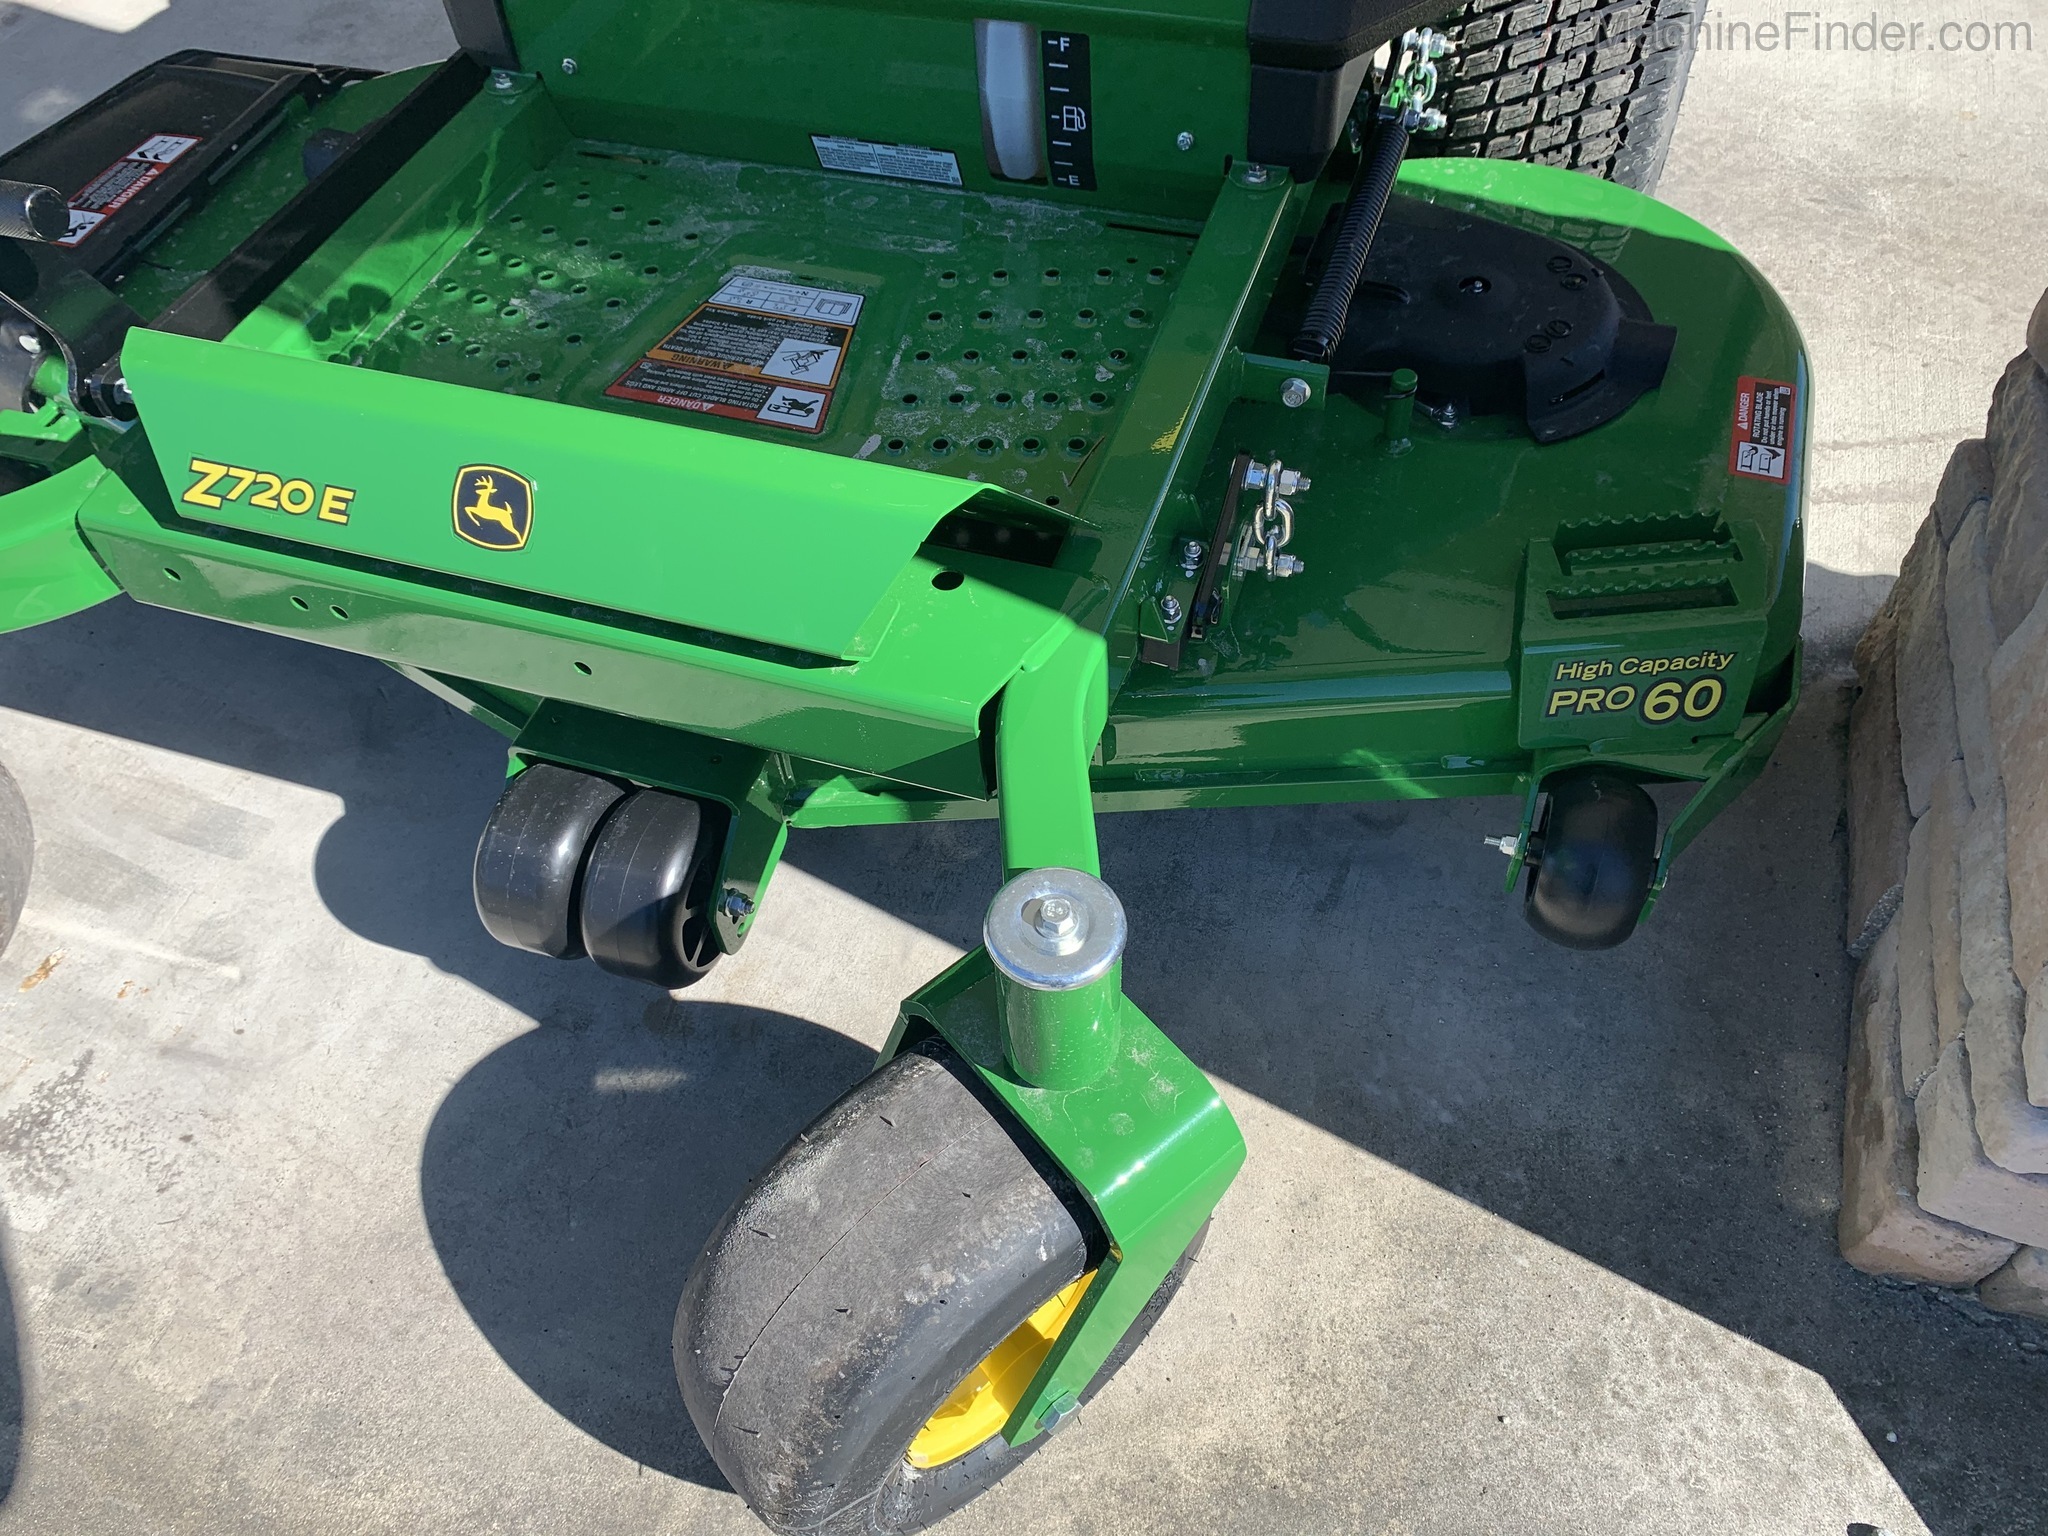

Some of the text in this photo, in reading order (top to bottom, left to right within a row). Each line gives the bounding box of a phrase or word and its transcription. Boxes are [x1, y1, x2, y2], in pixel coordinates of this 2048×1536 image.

[1060, 37, 1070, 52] F
[1068, 174, 1080, 186] E
[107, 176, 149, 208] DANGER
[671, 354, 720, 367] WARNING
[657, 395, 700, 409] DANGER
[702, 394, 726, 402] BLADES
[727, 399, 759, 408] ROTATING
[1738, 393, 1749, 421] DANGER
[1752, 392, 1763, 437] ROTATING BLADE
[1556, 652, 1735, 682] High Capacity
[1548, 678, 1723, 721] PRO 60
